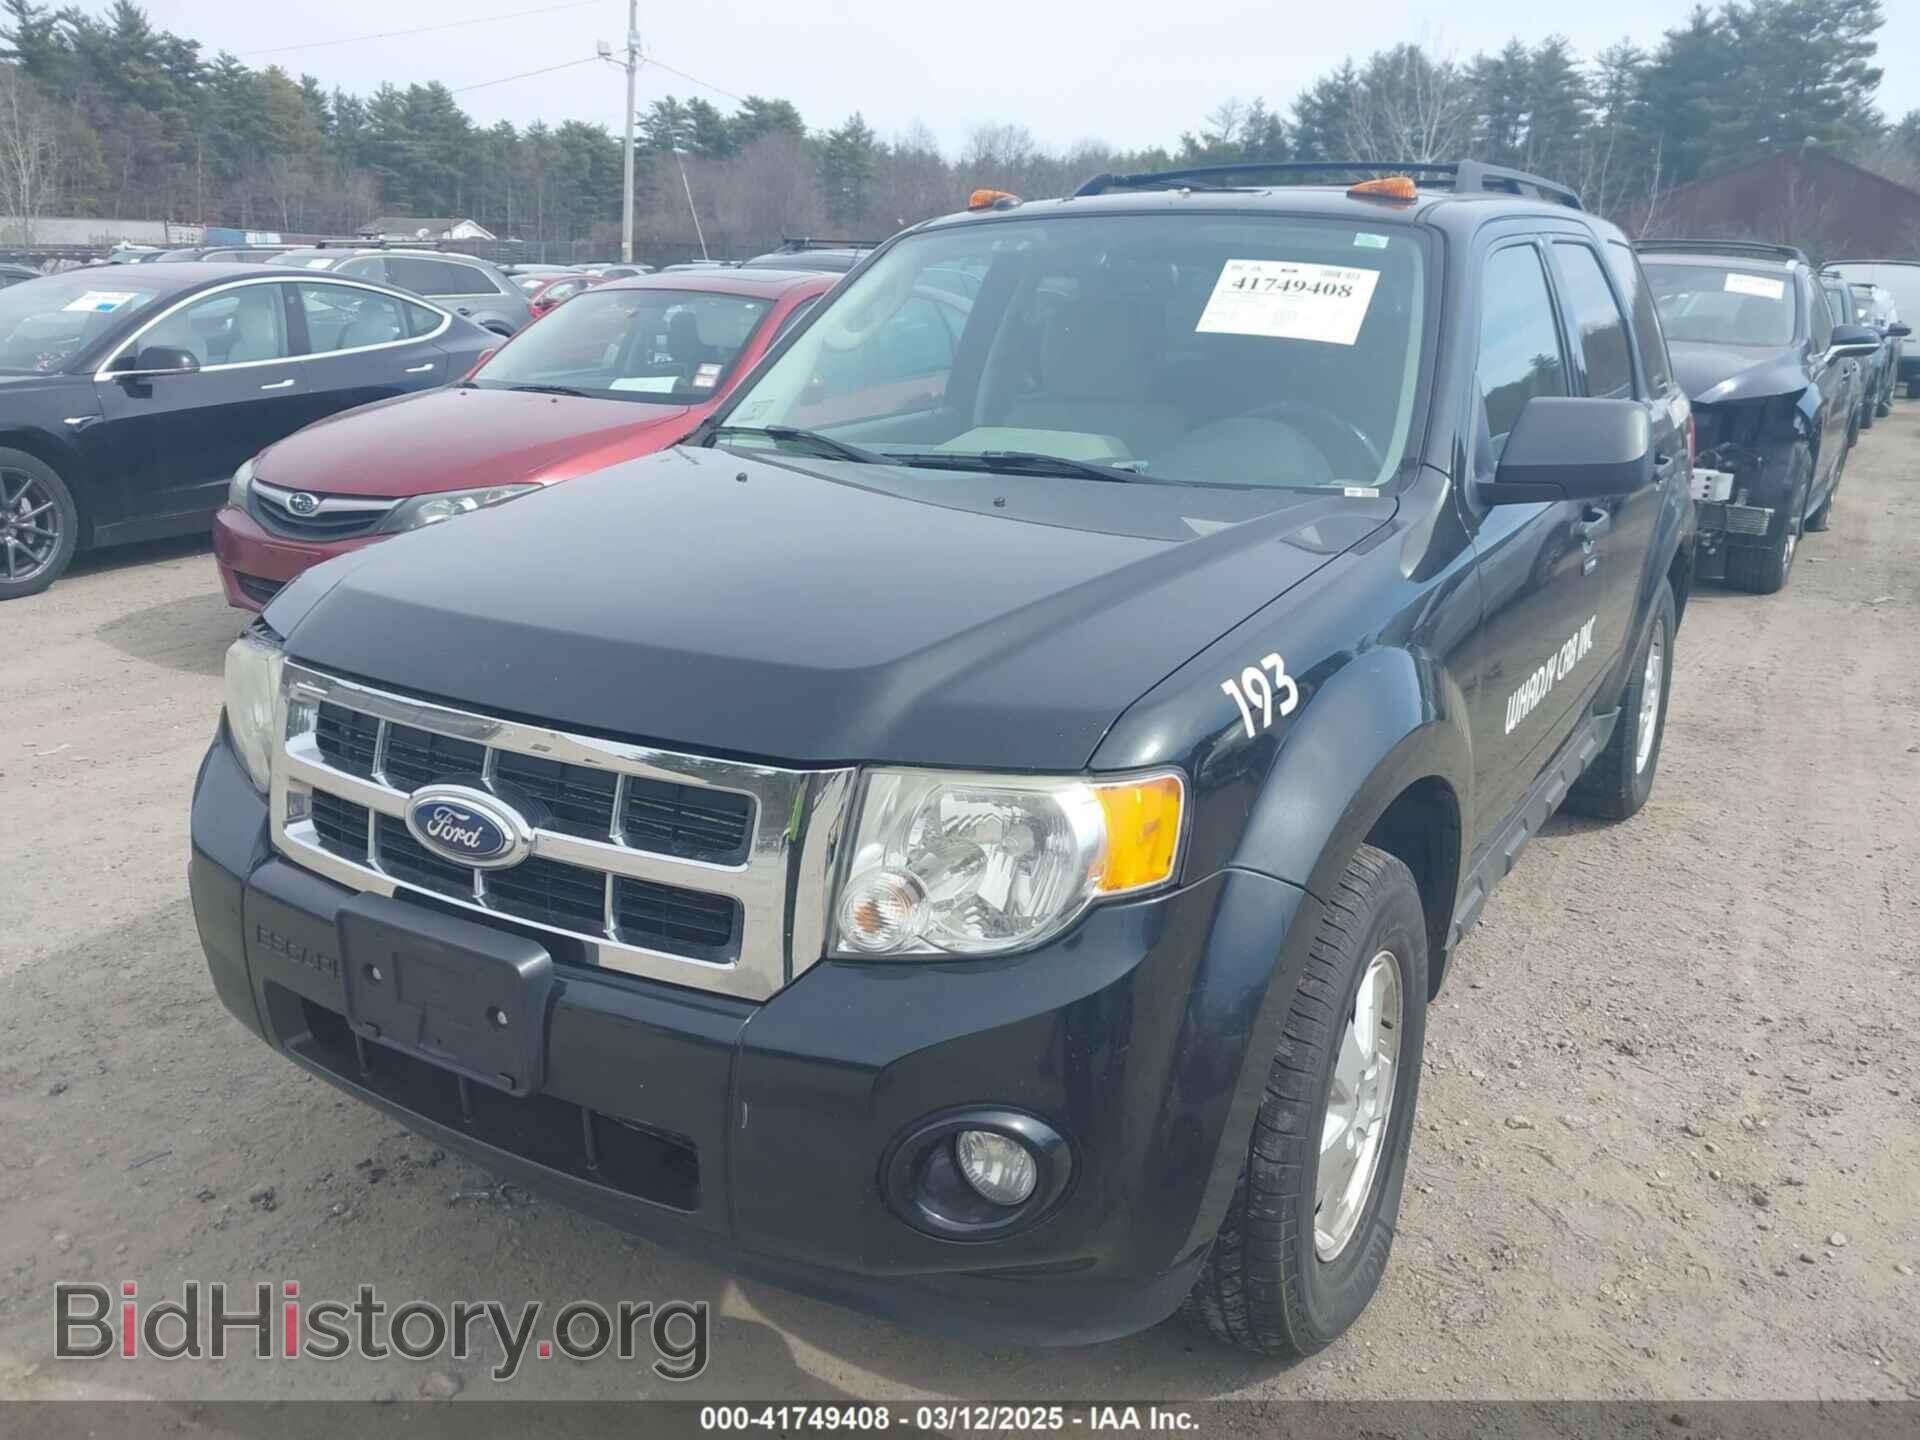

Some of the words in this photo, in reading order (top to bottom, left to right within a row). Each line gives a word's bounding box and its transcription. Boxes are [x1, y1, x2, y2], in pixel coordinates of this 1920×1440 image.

[1231, 276, 1353, 298] 41749408
[1220, 652, 1299, 739] 193
[426, 805, 483, 848] Ford
